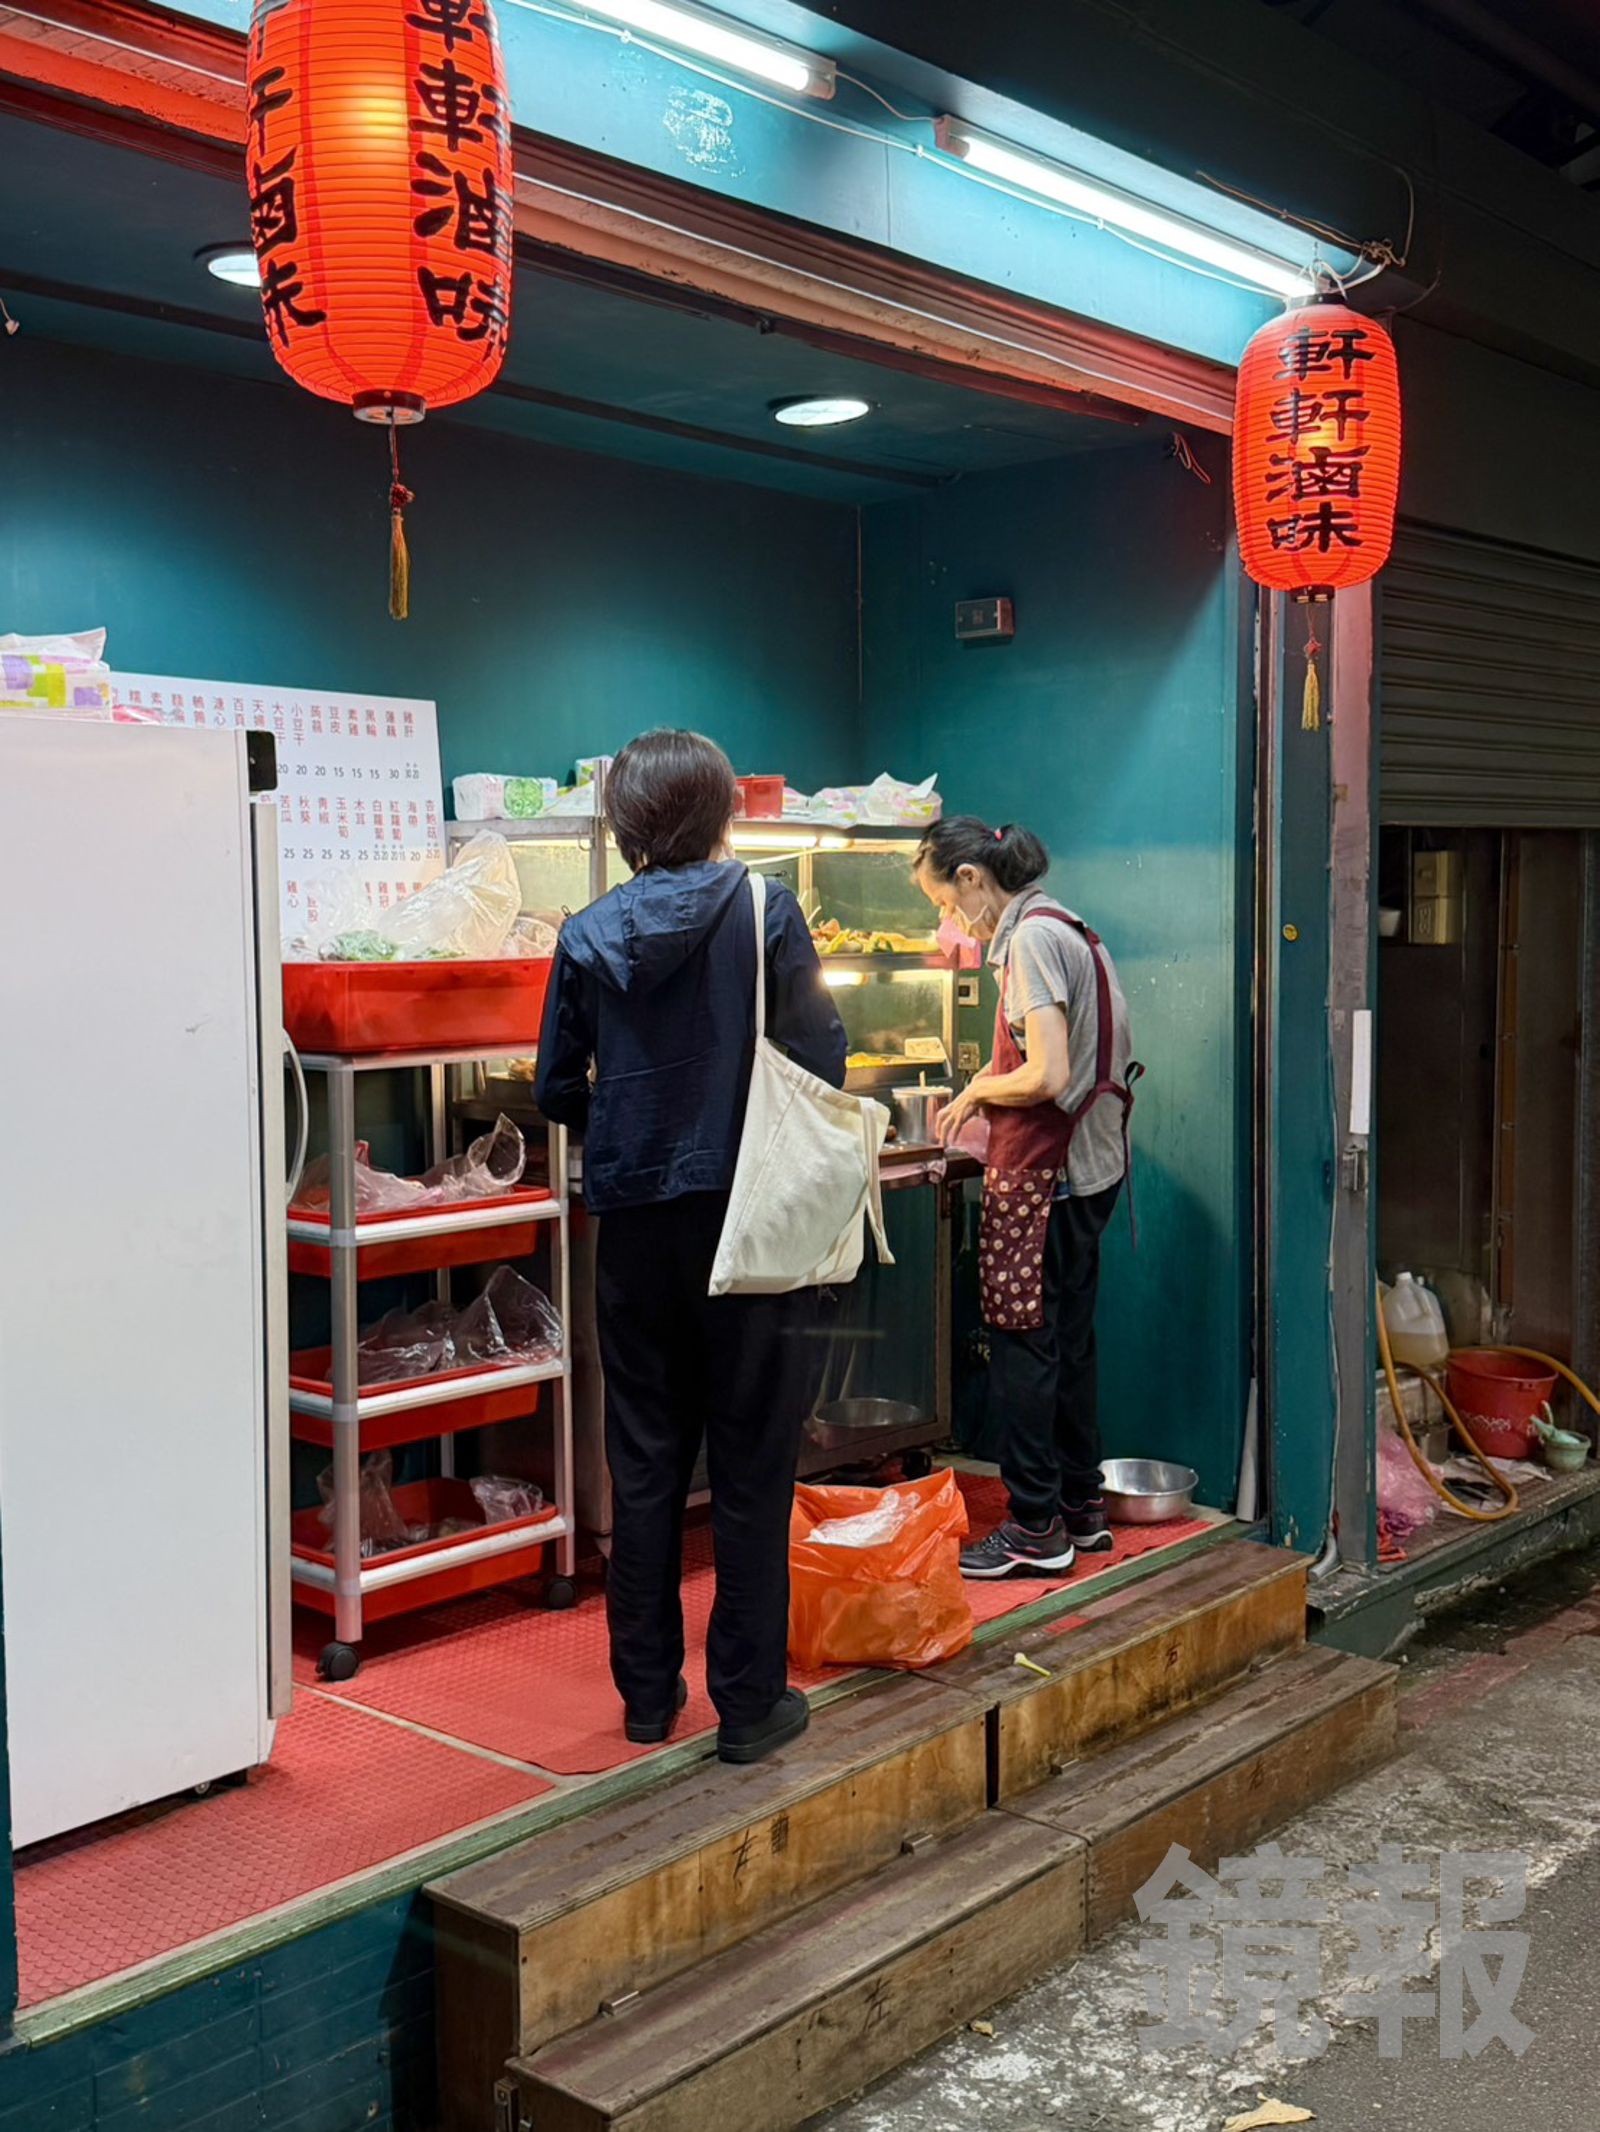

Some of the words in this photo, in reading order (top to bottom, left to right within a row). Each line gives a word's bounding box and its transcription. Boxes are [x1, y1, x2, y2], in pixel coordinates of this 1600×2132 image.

[1265, 326, 1375, 554] 軒軒滷味
[272, 702, 286, 744] 大豆干
[291, 703, 304, 746] 小豆干
[310, 705, 322, 733] 蒟蒻
[329, 706, 341, 734] 豆皮
[348, 708, 359, 737] 素雞
[365, 709, 377, 737] 黑輪
[403, 710, 414, 738] 雞肝
[296, 765, 307, 775] 20
[315, 766, 326, 776] 20
[334, 767, 344, 777] 15
[352, 768, 362, 778] 15
[370, 769, 380, 779] 15
[389, 769, 399, 779] 30
[280, 795, 292, 823] 苦瓜
[299, 795, 311, 824] 秋葵
[318, 797, 330, 825] 青椒
[336, 797, 349, 839] 玉米筍
[354, 798, 366, 825] 木耳
[372, 800, 384, 840] 白蘿蔔
[390, 800, 402, 841] 紅蘿蔔
[408, 800, 418, 827] 海帶
[284, 848, 295, 859] 25
[303, 848, 314, 859] 25
[321, 849, 332, 860] 25
[340, 849, 351, 860] 25
[358, 850, 369, 860] 25
[410, 851, 421, 861] 20
[287, 880, 298, 908] 雞心
